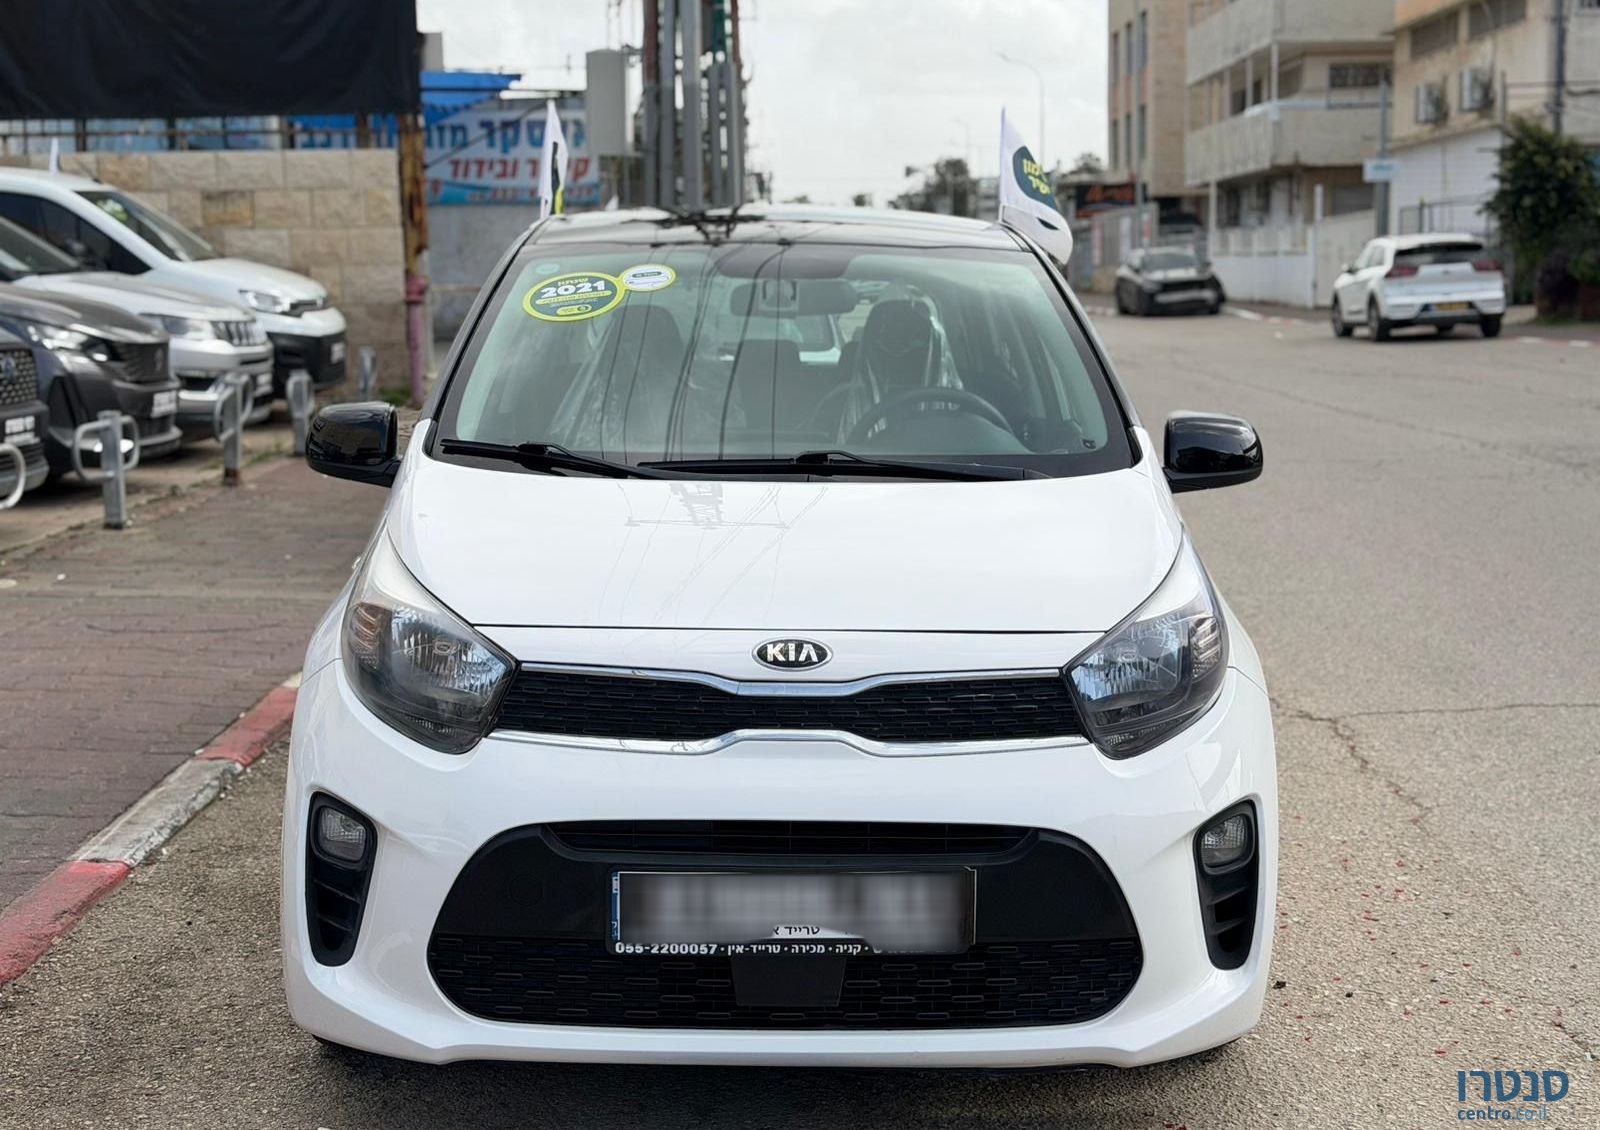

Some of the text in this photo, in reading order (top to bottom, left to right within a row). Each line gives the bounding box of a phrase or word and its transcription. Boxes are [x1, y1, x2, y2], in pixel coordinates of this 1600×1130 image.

[448, 158, 520, 180] ובידוד
[540, 280, 605, 298] 2021
[766, 642, 819, 662] KIA
[784, 925, 820, 935] טרייד
[615, 942, 718, 954] 055-2200057
[727, 943, 781, 956] טרייד-אין
[791, 943, 825, 954] מכירה
[835, 943, 862, 955] קניה
